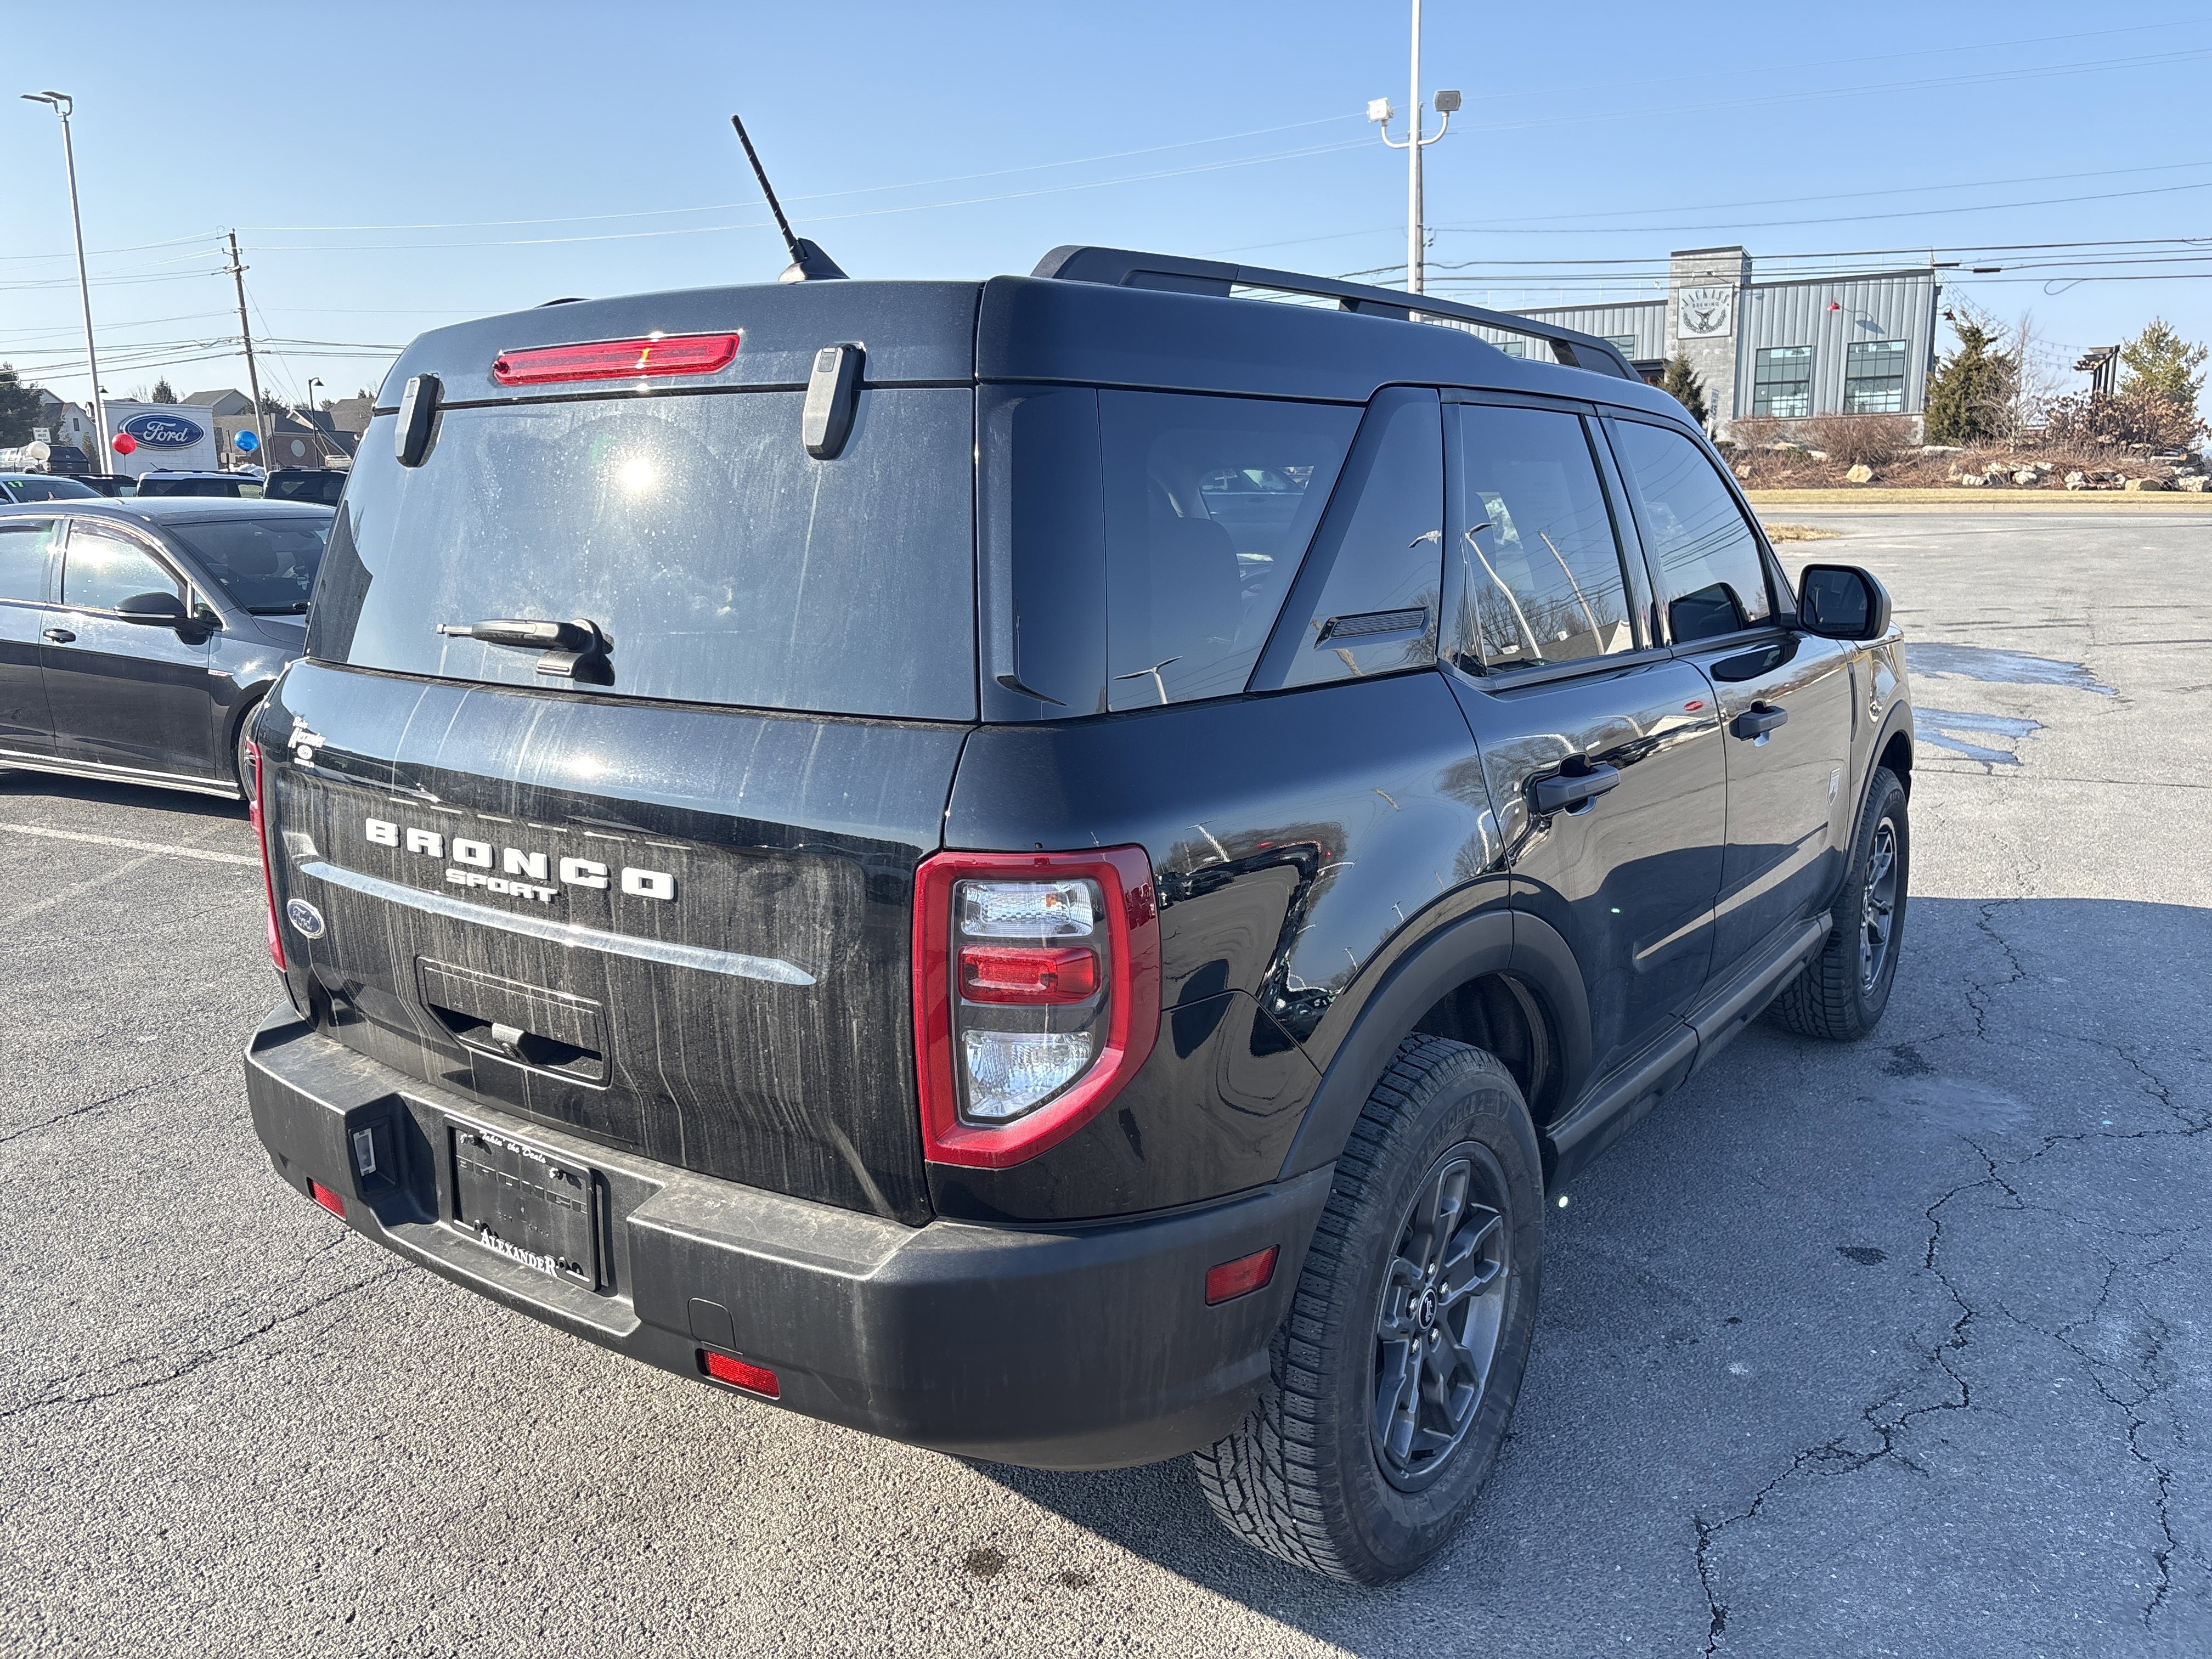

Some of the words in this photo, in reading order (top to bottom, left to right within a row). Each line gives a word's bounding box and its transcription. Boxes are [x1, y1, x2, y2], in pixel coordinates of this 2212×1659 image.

[143, 421, 188, 442] Ford
[365, 817, 675, 901] BRONCO
[445, 868, 559, 902] SPORT
[292, 906, 313, 931] Ford
[507, 1143, 520, 1153] the
[522, 1147, 547, 1164] Deals
[480, 1227, 557, 1277] ALEXANDER
